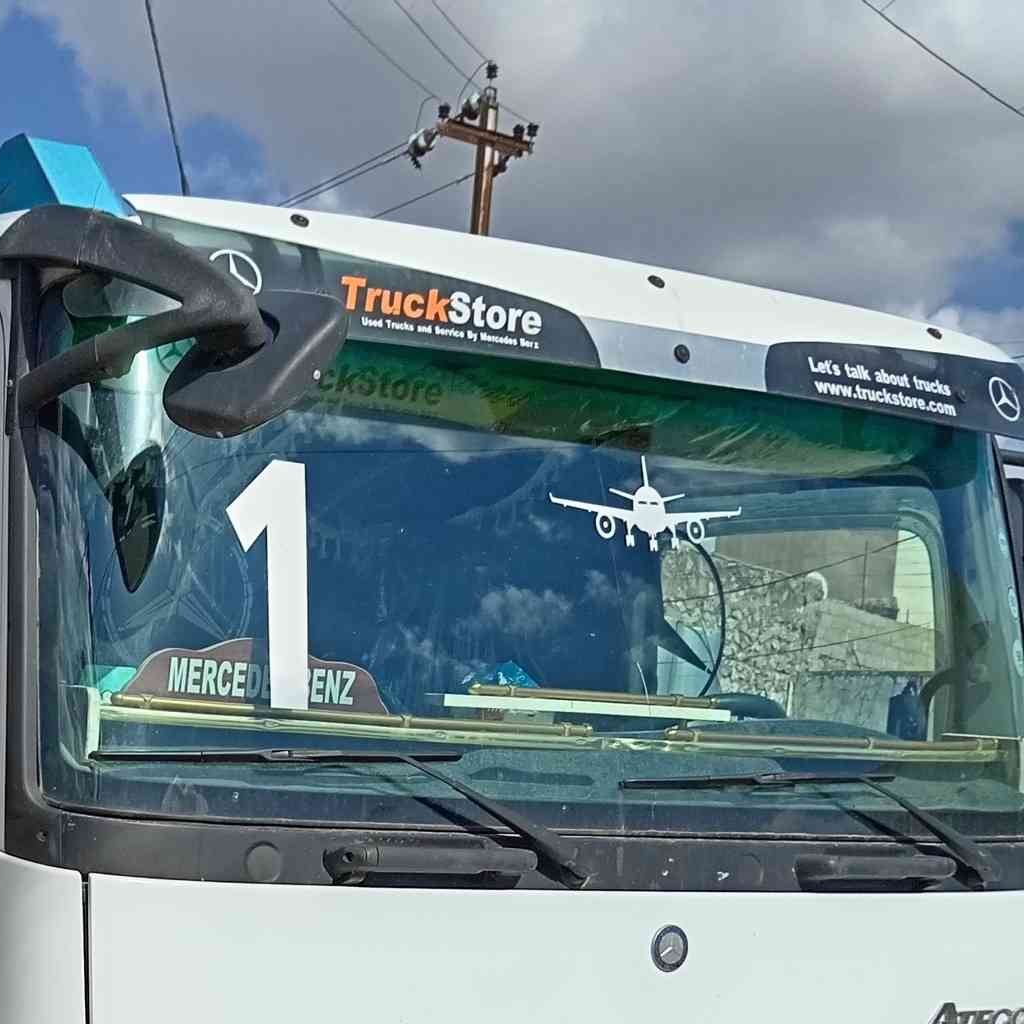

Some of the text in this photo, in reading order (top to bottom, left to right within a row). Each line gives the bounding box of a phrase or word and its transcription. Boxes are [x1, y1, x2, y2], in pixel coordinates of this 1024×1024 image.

[341, 276, 542, 335] TruckStore
[361, 316, 383, 328] Used
[385, 319, 414, 332] Trucks
[417, 324, 432, 334] and
[435, 325, 464, 338] Service
[480, 331, 517, 347] Mercedes
[808, 356, 952, 397] Let's talk about trucks
[814, 381, 957, 417] www.truckstore.com
[225, 459, 309, 711] 1
[167, 656, 356, 706] MERCEDE ENZ
